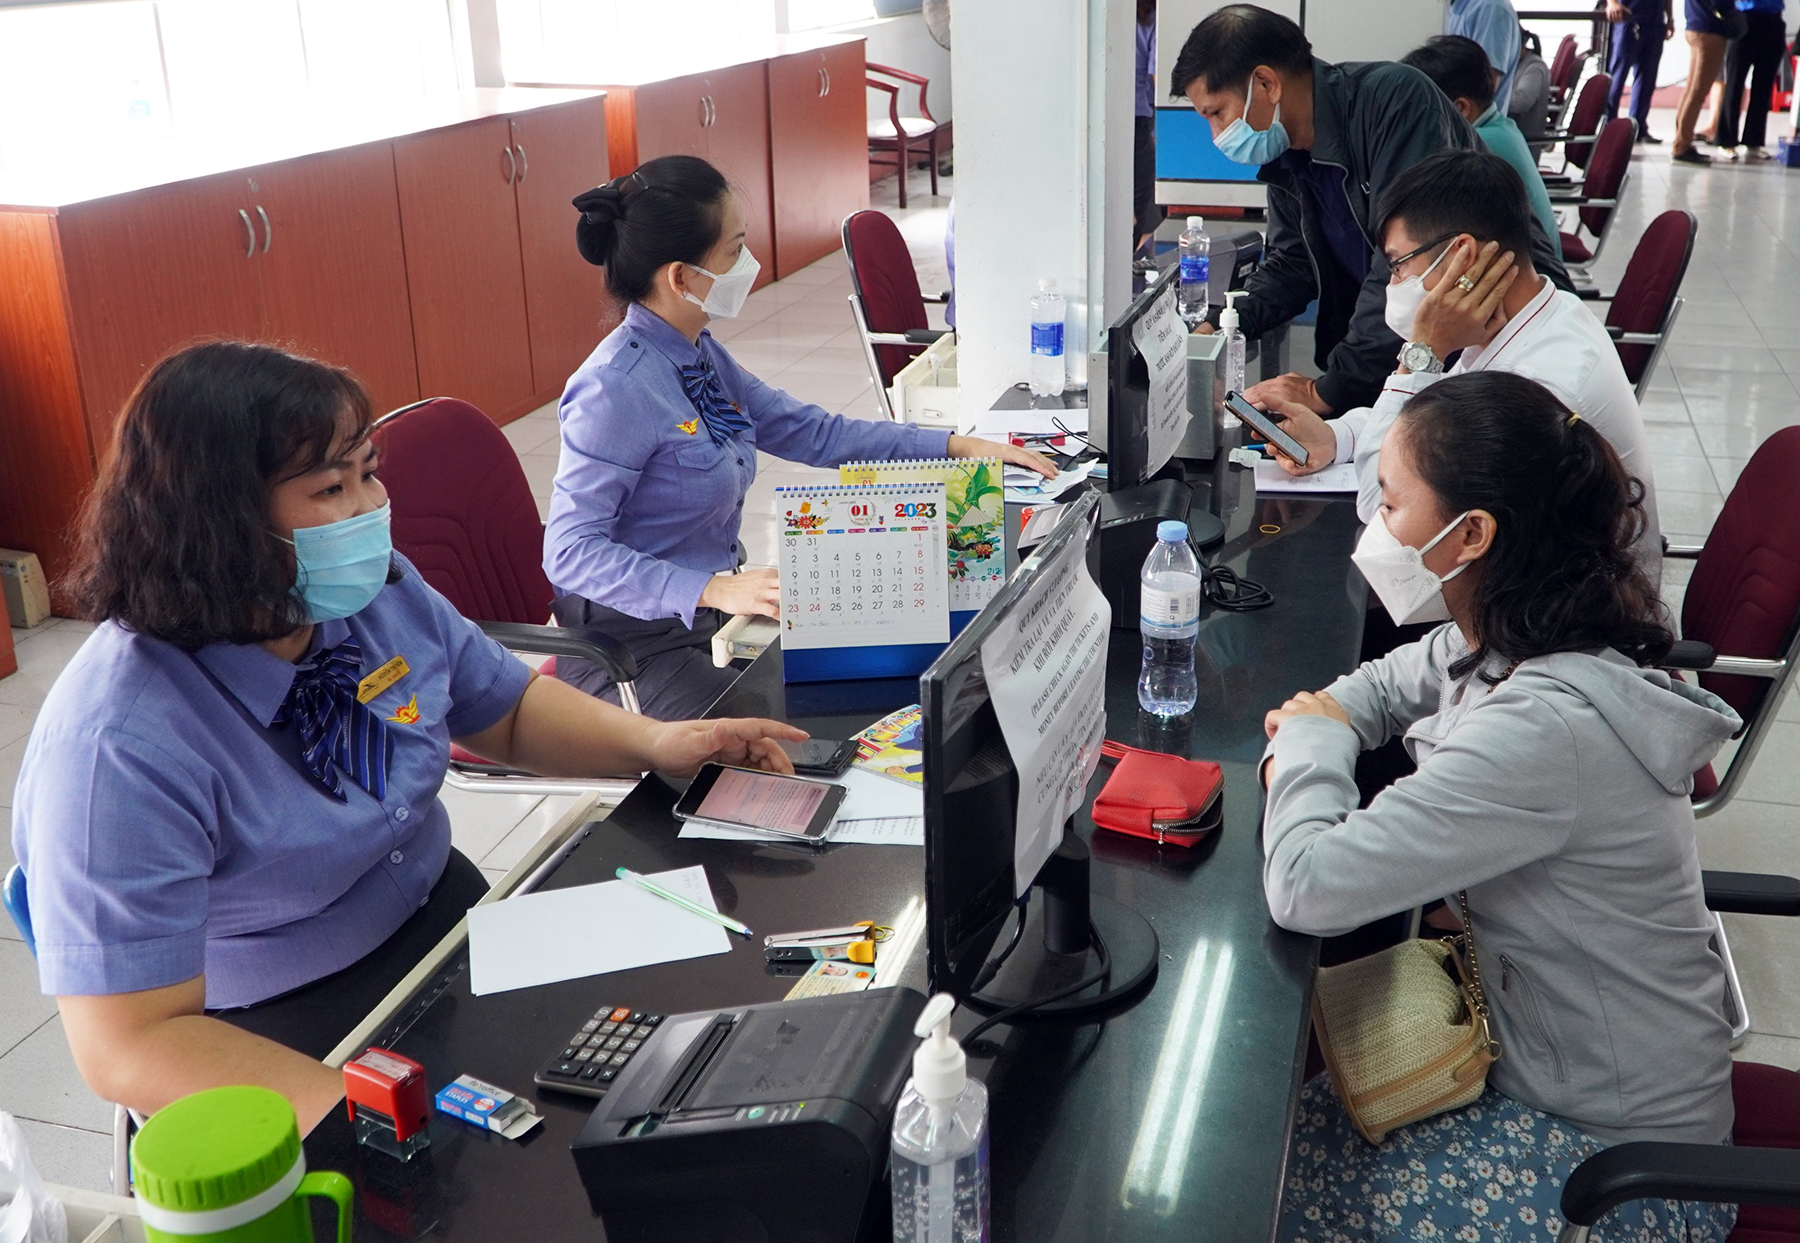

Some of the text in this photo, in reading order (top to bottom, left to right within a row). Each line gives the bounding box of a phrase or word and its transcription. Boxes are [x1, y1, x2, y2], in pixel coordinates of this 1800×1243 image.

[851, 504, 868, 516] 01
[894, 502, 937, 518] 2023
[786, 538, 797, 547] 30
[807, 537, 817, 546] 31
[792, 555, 797, 563] 2
[813, 554, 819, 562] 3
[834, 554, 840, 562] 4
[855, 552, 861, 561] 5
[876, 552, 882, 560] 6
[917, 550, 924, 558] 8
[792, 566, 924, 580] 9 10 11 12 13 14 15
[788, 583, 924, 597] 16 17 18 19 20 21 22
[788, 599, 925, 613] 23 24 25 26 27 28 29
[1024, 638, 1036, 661] TRA
[1031, 612, 1100, 719] (PLEASE CHECK AGAIN THE TICKETS AND
[1033, 652, 1045, 674] KHI
[1038, 708, 1054, 738] MONEY
[1052, 688, 1069, 715] BEFORE
[1068, 666, 1085, 694] LEAVING
[1082, 655, 1090, 670] THE
[1088, 628, 1106, 660] COUNTER)
[444, 1090, 469, 1104] STAPLES
